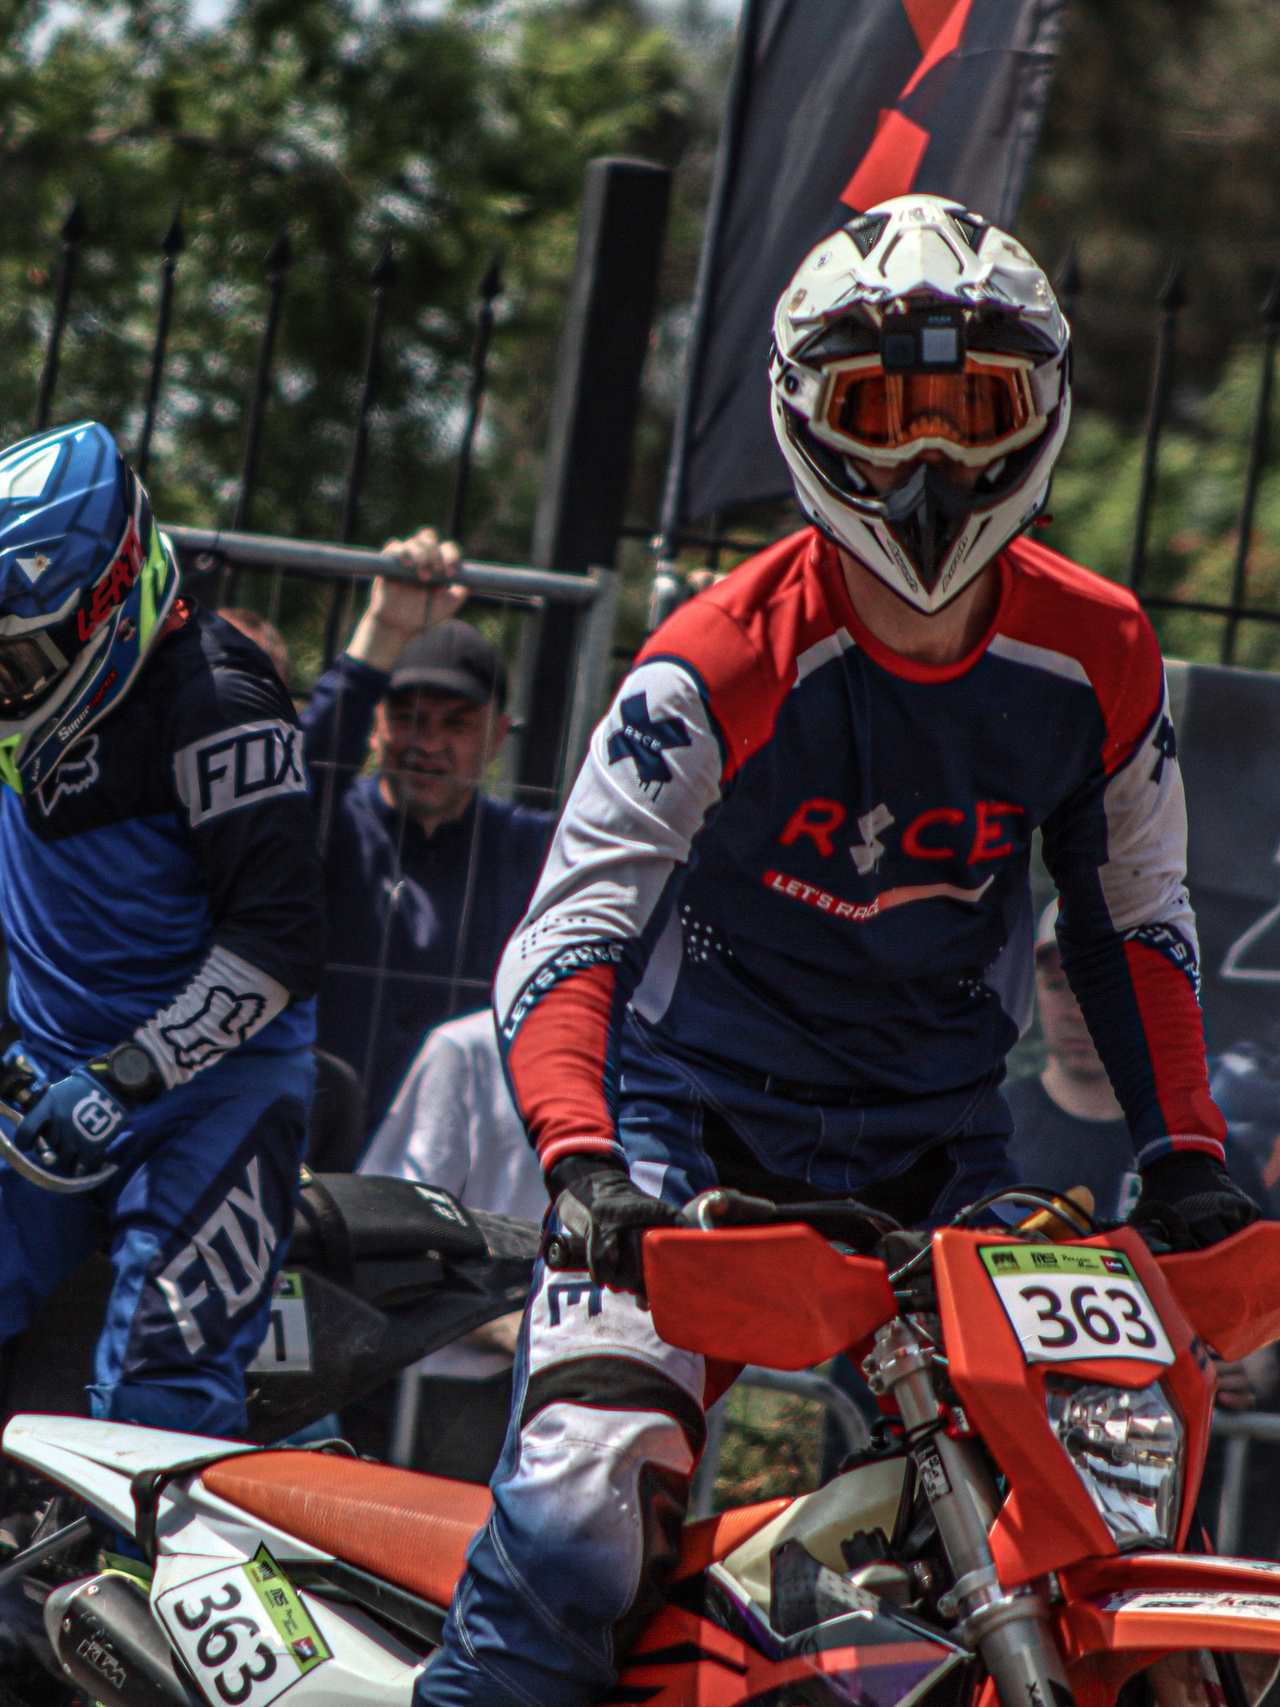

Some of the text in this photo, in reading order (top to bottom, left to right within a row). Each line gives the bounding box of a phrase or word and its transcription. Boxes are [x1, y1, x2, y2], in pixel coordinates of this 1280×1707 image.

[196, 726, 304, 813] FOX
[771, 873, 834, 912] LET'S
[155, 1154, 279, 1356] FOX
[1019, 1285, 1157, 1349] 363
[173, 1583, 278, 1706] 363
